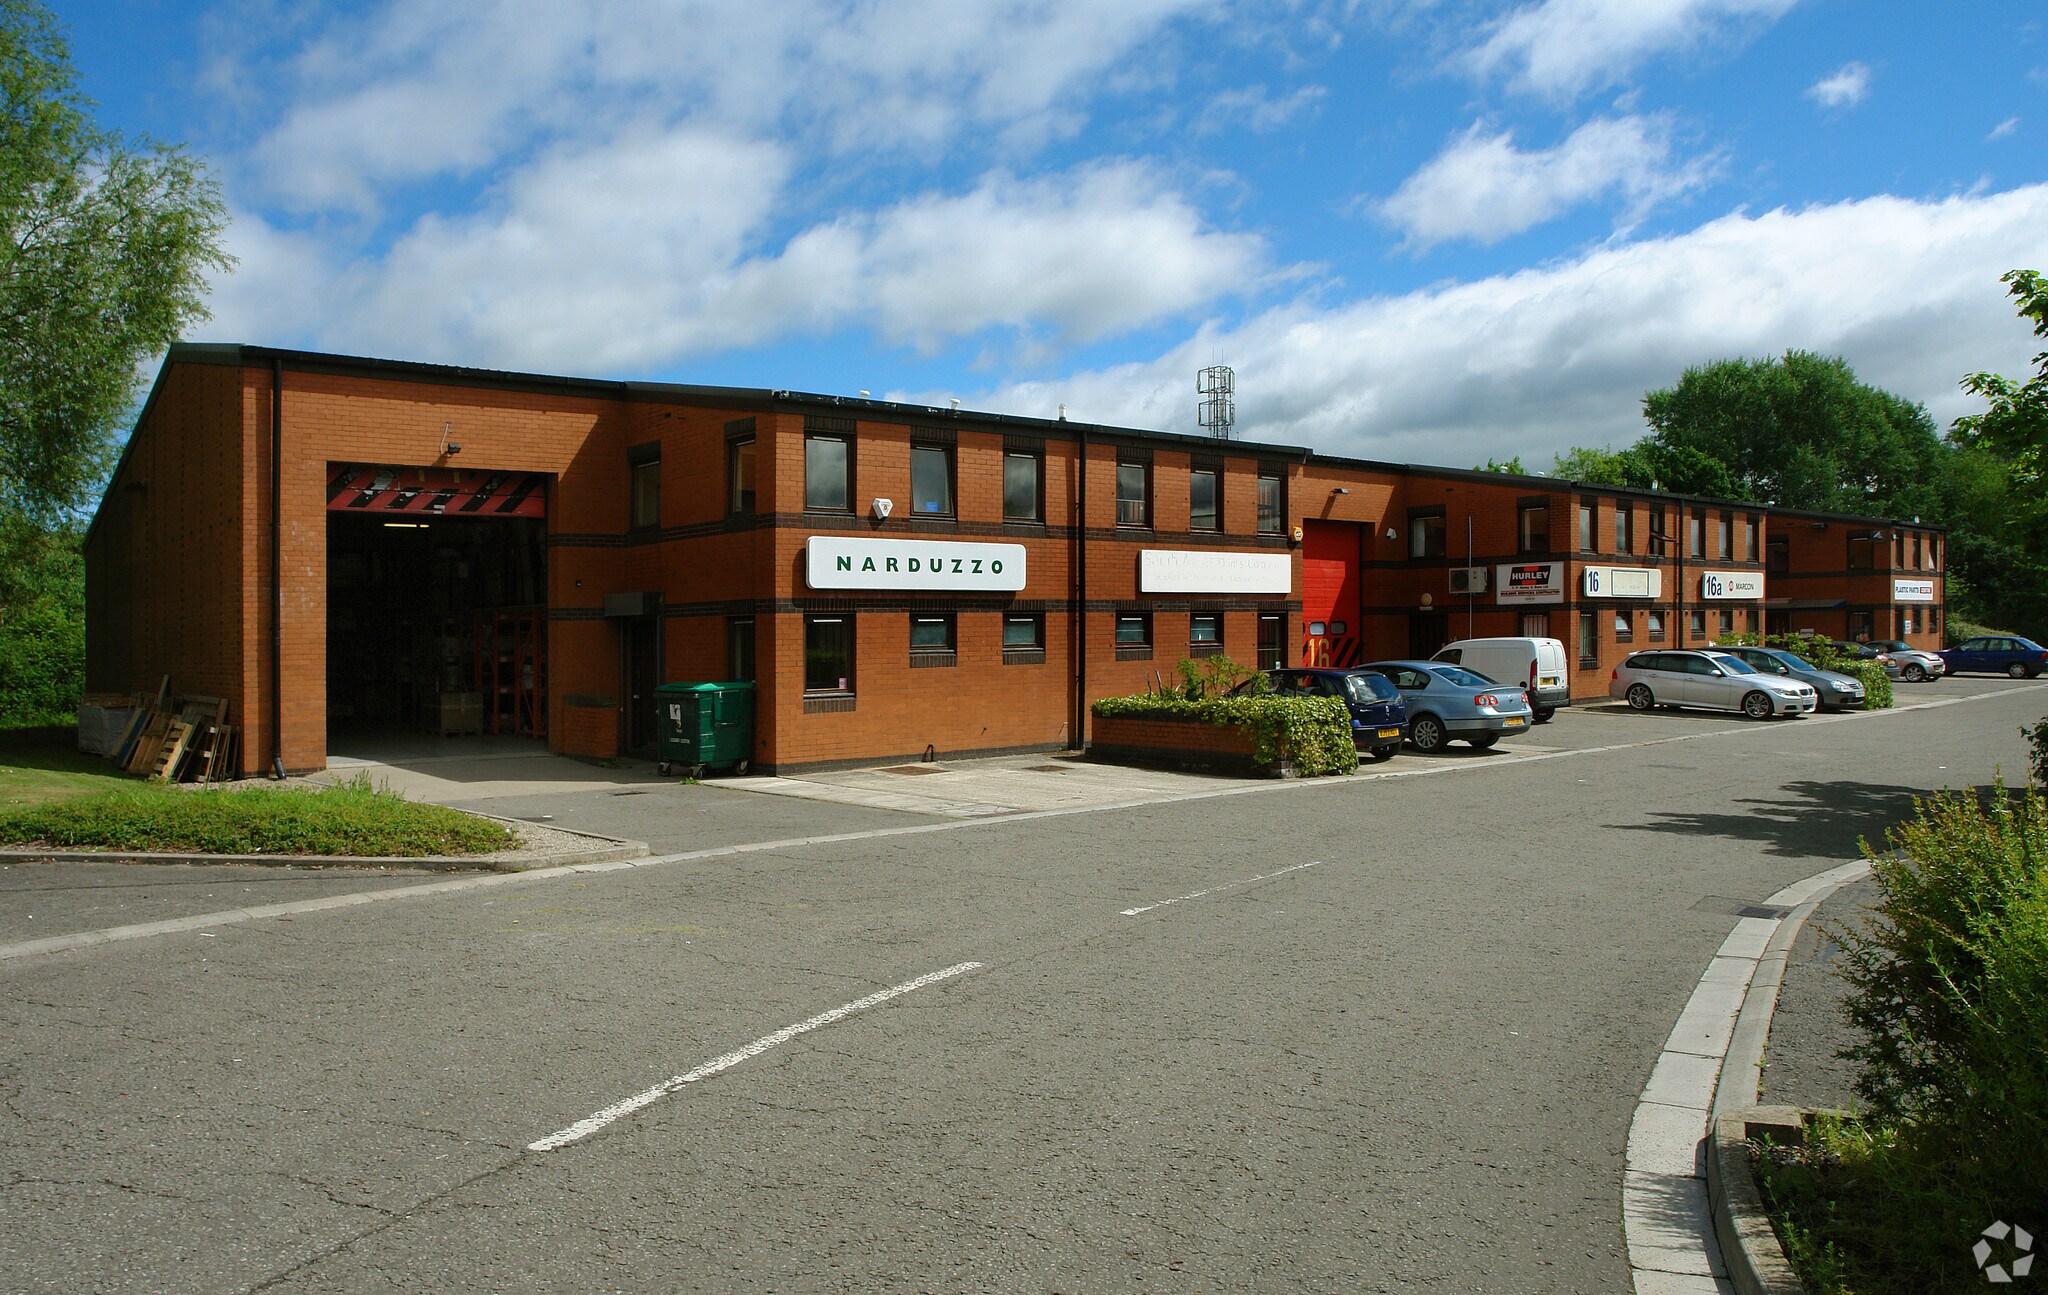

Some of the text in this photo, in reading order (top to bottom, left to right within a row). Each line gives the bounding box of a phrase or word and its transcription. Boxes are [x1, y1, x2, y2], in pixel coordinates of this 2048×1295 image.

[836, 556, 1003, 574] NARDUZZO
[1512, 572, 1548, 580] HURLEY
[1588, 571, 1599, 592] 16
[1706, 576, 1722, 596] 16a
[1309, 638, 1330, 668] 16
